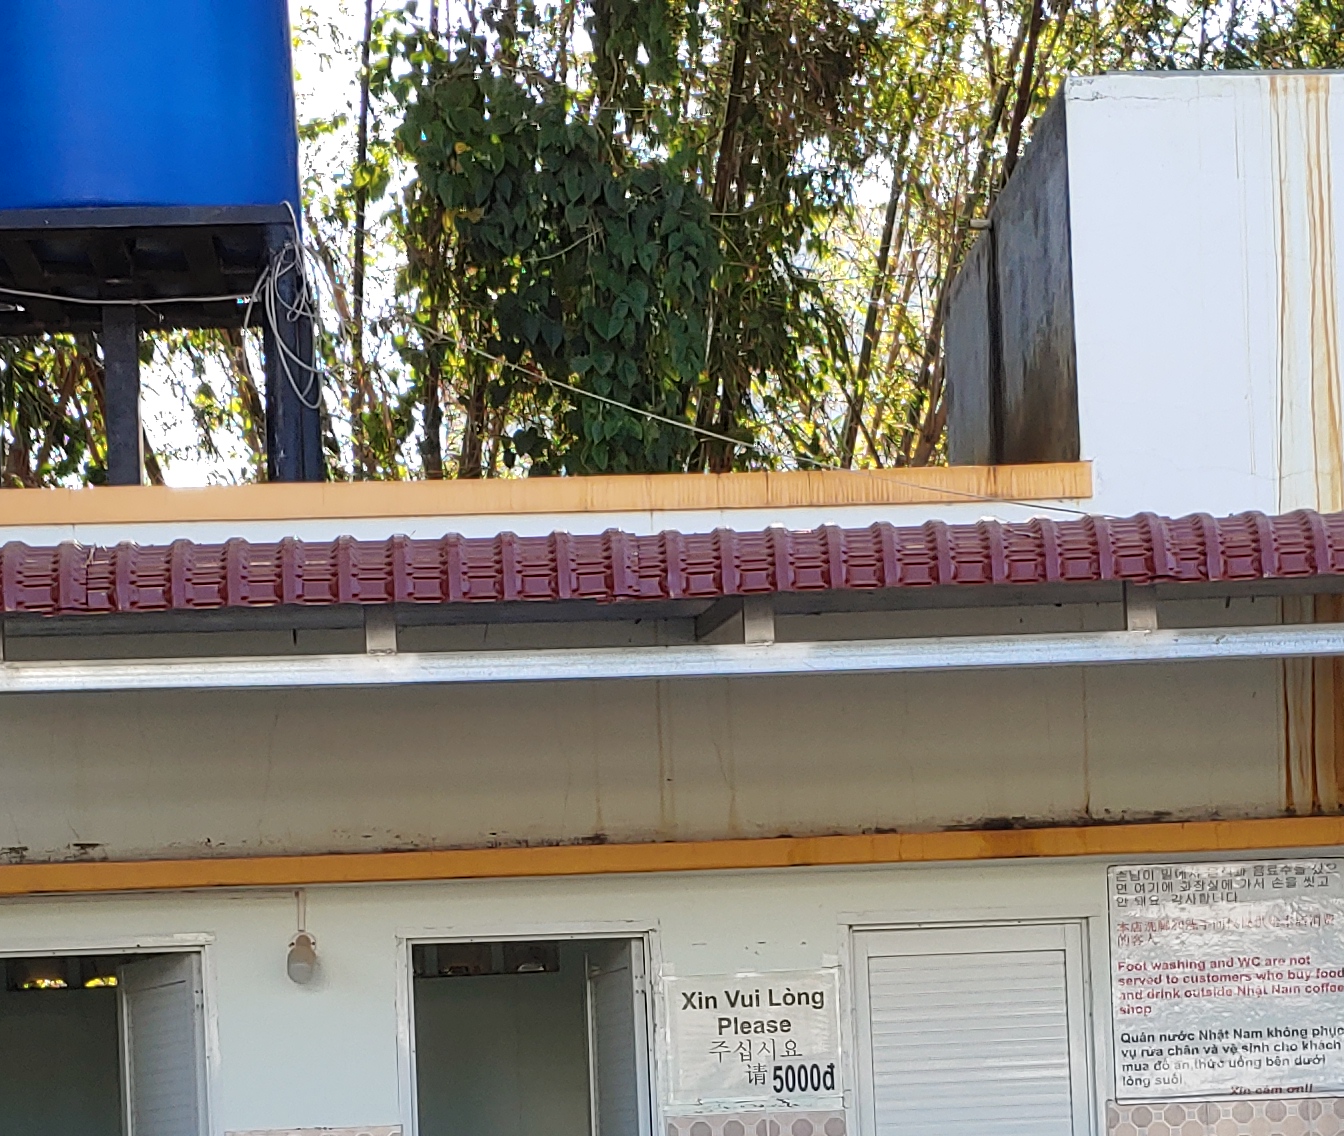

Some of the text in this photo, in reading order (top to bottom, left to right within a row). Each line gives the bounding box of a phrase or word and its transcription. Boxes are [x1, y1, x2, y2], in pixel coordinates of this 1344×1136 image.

[1116, 883, 1128, 895] 면
[1134, 881, 1174, 894] 여기에
[1238, 878, 1265, 890] 가서
[1272, 876, 1297, 889] 손을
[1303, 876, 1330, 888] 씻고
[1116, 896, 1129, 908] 안
[1118, 955, 1311, 972] Foot washing and WC are not
[1118, 967, 1344, 986] served to customers who buy food
[681, 987, 825, 1011] Xin Vui Lòng
[1119, 989, 1143, 1000] and
[1147, 988, 1181, 999] drink
[1184, 986, 1233, 998] outside
[1272, 984, 1301, 994] Nam
[1305, 982, 1344, 994] coffee
[1119, 1005, 1152, 1017] shop
[718, 1016, 792, 1035] Please
[1120, 1031, 1155, 1043] Quán
[1159, 1030, 1195, 1042] nước
[1199, 1028, 1229, 1043] Nhật
[1233, 1028, 1263, 1039] Nam
[1267, 1026, 1308, 1039] không
[708, 1038, 803, 1063] 주십시요
[1121, 1039, 1342, 1060] vụ rửa chân và vệ sinh cho khách
[1122, 1062, 1150, 1072] mua
[1265, 1055, 1290, 1067] bên
[1294, 1054, 1326, 1066] dưới
[745, 1063, 768, 1086] 请
[772, 1062, 836, 1093] 5000đ
[1122, 1076, 1151, 1088] lòng
[1230, 1086, 1251, 1096] Xin
